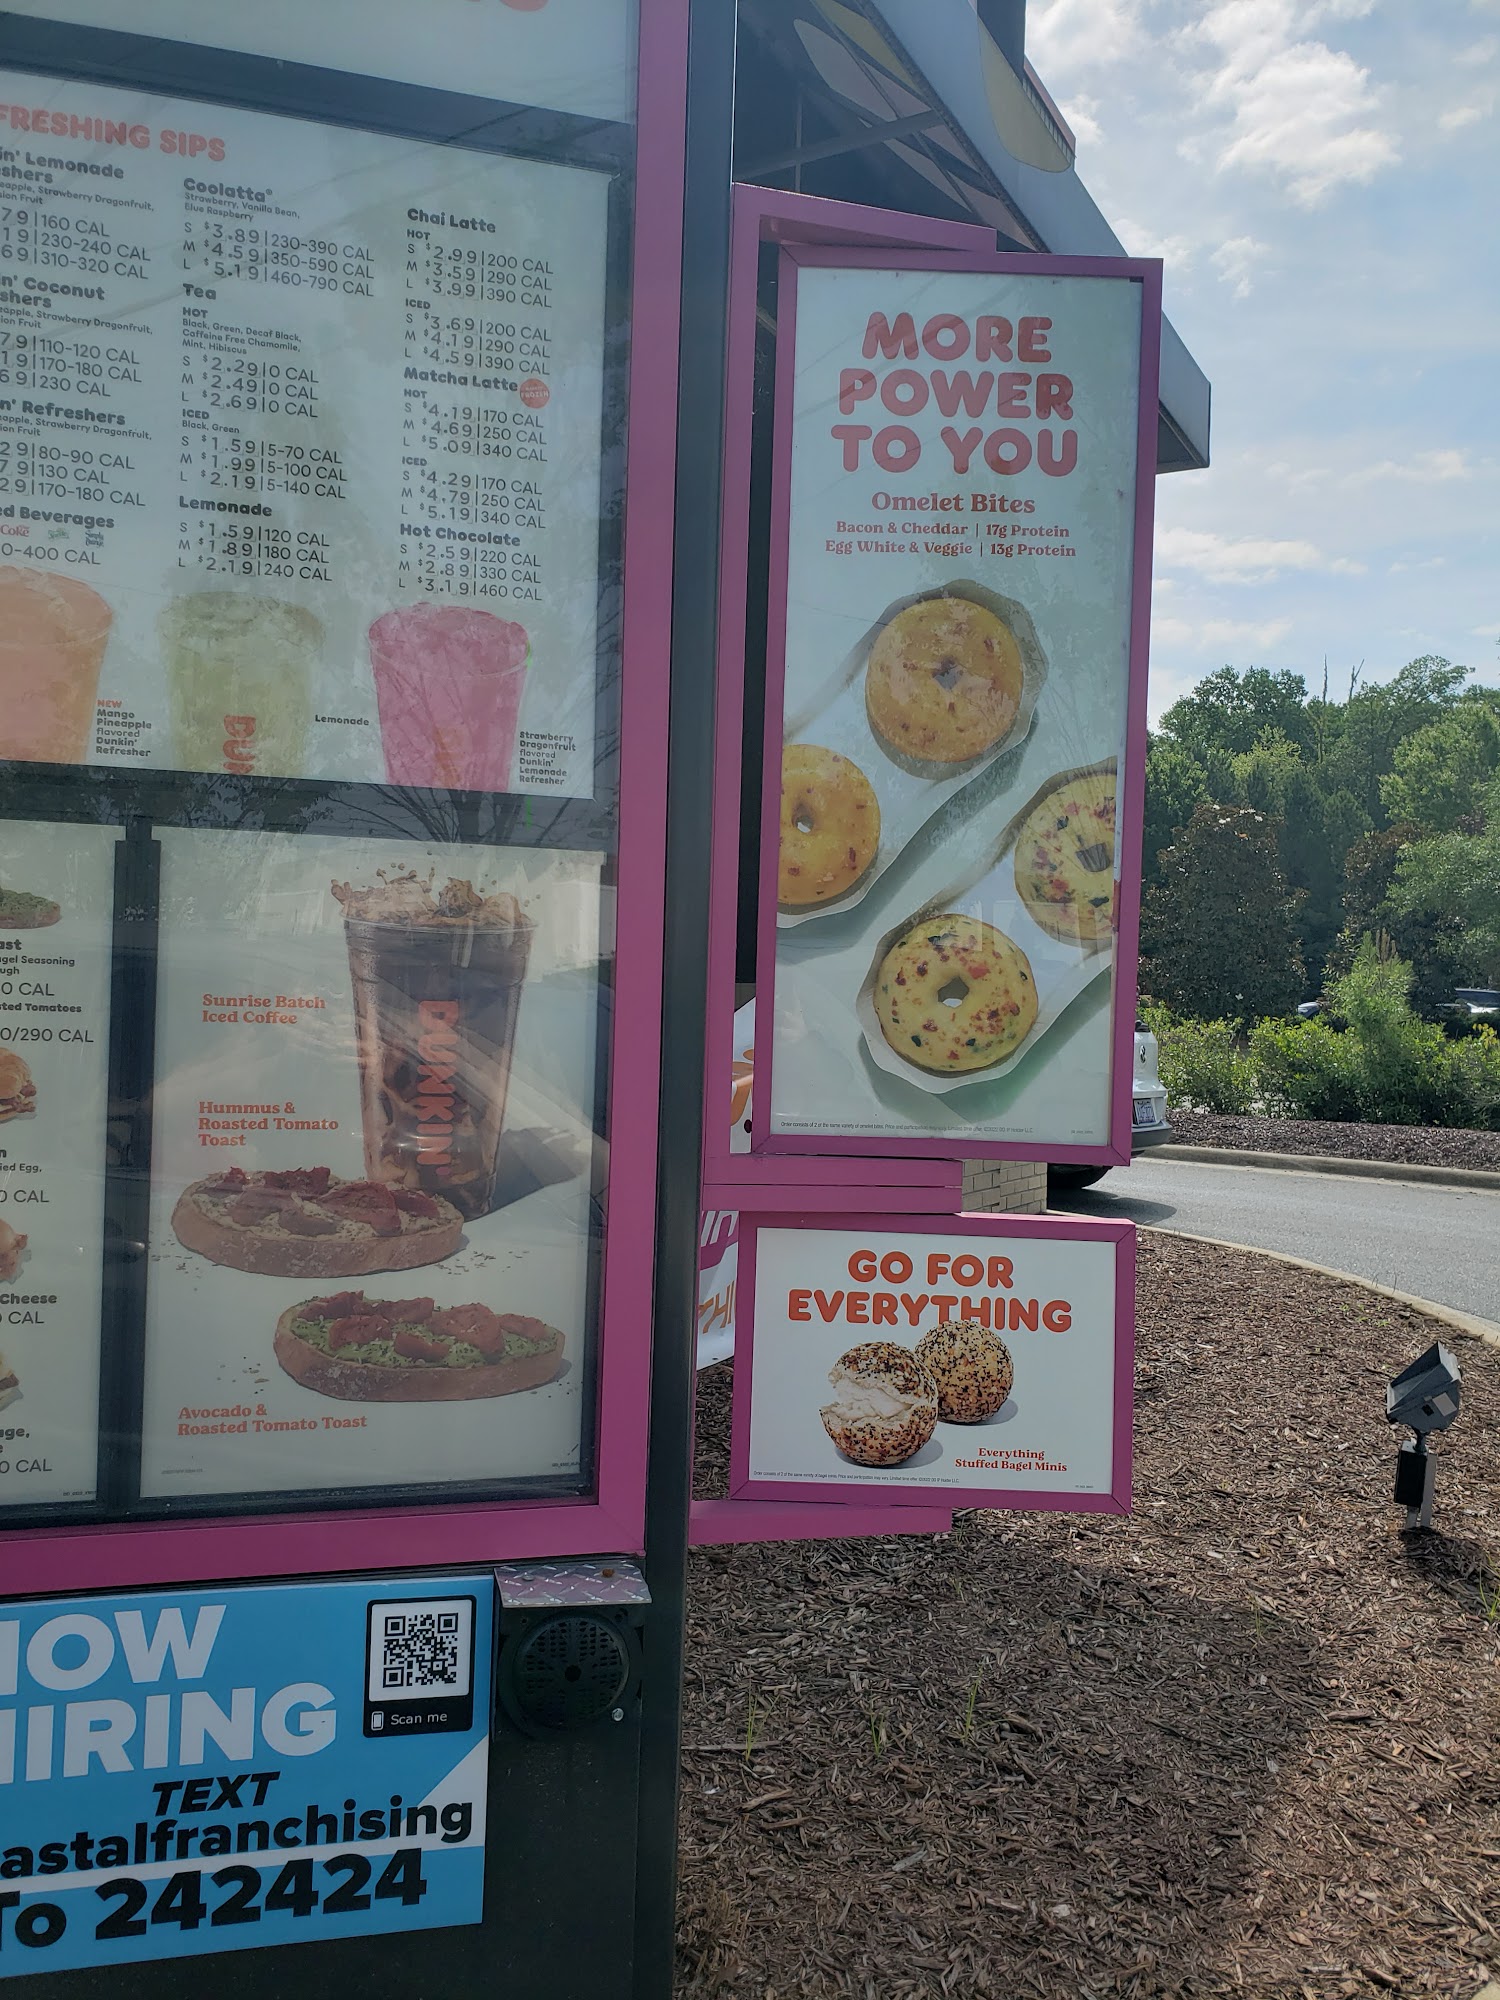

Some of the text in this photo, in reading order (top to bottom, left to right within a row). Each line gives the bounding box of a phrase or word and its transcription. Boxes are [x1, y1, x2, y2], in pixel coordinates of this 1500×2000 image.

[160, 129, 226, 162] SIPS
[26, 152, 124, 179] Lemonade
[20, 193, 44, 205] Fruit
[38, 185, 93, 202] Strawberry
[95, 194, 154, 212] Dragonfruit,
[184, 192, 301, 219] Strawberry, Vanilla Bean,
[184, 202, 254, 223] Blue Raspberry
[407, 208, 496, 233] Chai Latte
[184, 222, 192, 233] S
[342, 244, 375, 262] CAL
[406, 229, 430, 240] HOT
[407, 244, 415, 254] S
[522, 258, 554, 274] CAL
[406, 261, 552, 291] M CAL
[24, 277, 105, 300] Coconut
[182, 283, 217, 300] Tea
[405, 298, 431, 309] ICED
[182, 307, 208, 318] HOT
[18, 317, 42, 329] Fruit
[36, 310, 153, 335] Strawberry Dragonfruit,
[182, 318, 301, 343] Black, Green, Decaf Black,
[862, 312, 1053, 363] MORE
[182, 328, 301, 353] Caffeine Free Chamomile,
[182, 339, 247, 355] Mint, Hibiscus
[403, 367, 518, 392] Matcha Latte
[404, 388, 427, 399] HOT
[839, 368, 1074, 421] POWER
[22, 400, 126, 426] Refreshers
[182, 409, 210, 420] ICED
[18, 426, 41, 436] Fruit
[36, 418, 152, 441] Strawberry Dragonfruit,
[182, 420, 240, 434] Black, Green
[831, 425, 1078, 477] TO YOU
[402, 456, 427, 466] ICED
[179, 495, 273, 517] Lemonade
[871, 491, 1036, 513] Omelet Bites
[19, 506, 115, 530] Beverages
[180, 522, 188, 533] S
[296, 531, 330, 547] CAL
[400, 524, 521, 547] Hot Chocolate
[836, 521, 883, 534] Bacon
[887, 522, 897, 534] &
[901, 522, 968, 535] Cheddar
[986, 524, 1007, 538] 17g
[1010, 525, 1070, 538] Protein
[825, 540, 853, 554] Egg
[857, 541, 905, 553] White
[909, 542, 919, 553] &
[924, 542, 973, 557] Veggie
[990, 543, 1013, 557] 13g
[1017, 543, 1076, 557] Protein
[64, 548, 101, 565] CAL
[97, 699, 122, 708] NEW
[97, 708, 135, 720] Mango
[314, 714, 370, 726] Lemonade
[96, 718, 152, 730] Pineapple
[96, 727, 140, 738] flavored
[519, 731, 574, 743] Strawberry
[96, 736, 137, 747] Dunkin'
[519, 740, 577, 752] Dragonfruit
[95, 745, 151, 757] Refresher
[519, 749, 556, 759] flavored
[519, 757, 554, 767] Dunkin'
[519, 766, 568, 777] Lemonade
[519, 775, 565, 786] Refresher
[21, 956, 75, 967] Seasoning
[18, 983, 55, 996] CAL
[25, 1003, 82, 1013] Tomatoes
[202, 994, 326, 1009] Sunrise Batch
[202, 1010, 298, 1025] Iced Coffee
[59, 1029, 94, 1042] CAL
[199, 1101, 296, 1114] Hummus &
[198, 1117, 339, 1130] Roasted Tomato
[198, 1134, 246, 1147] Toast
[19, 1163, 42, 1173] Egg,
[13, 1190, 49, 1203] CAL
[847, 1249, 1015, 1289] GO FOR
[1, 1293, 57, 1304] Cheese
[8, 1311, 44, 1324] CAL
[787, 1289, 1073, 1333] EVERYTHING
[178, 1403, 267, 1420] Avocado &
[177, 1415, 367, 1436] Roasted Tomato Toast
[978, 1447, 1045, 1461] Everything
[16, 1459, 52, 1473] CAL
[955, 1458, 1068, 1473] Stuffed Bagel Minis
[390, 1711, 448, 1725] Scan me
[152, 1770, 281, 1817] TEXT
[95, 1847, 427, 1941] 242424
